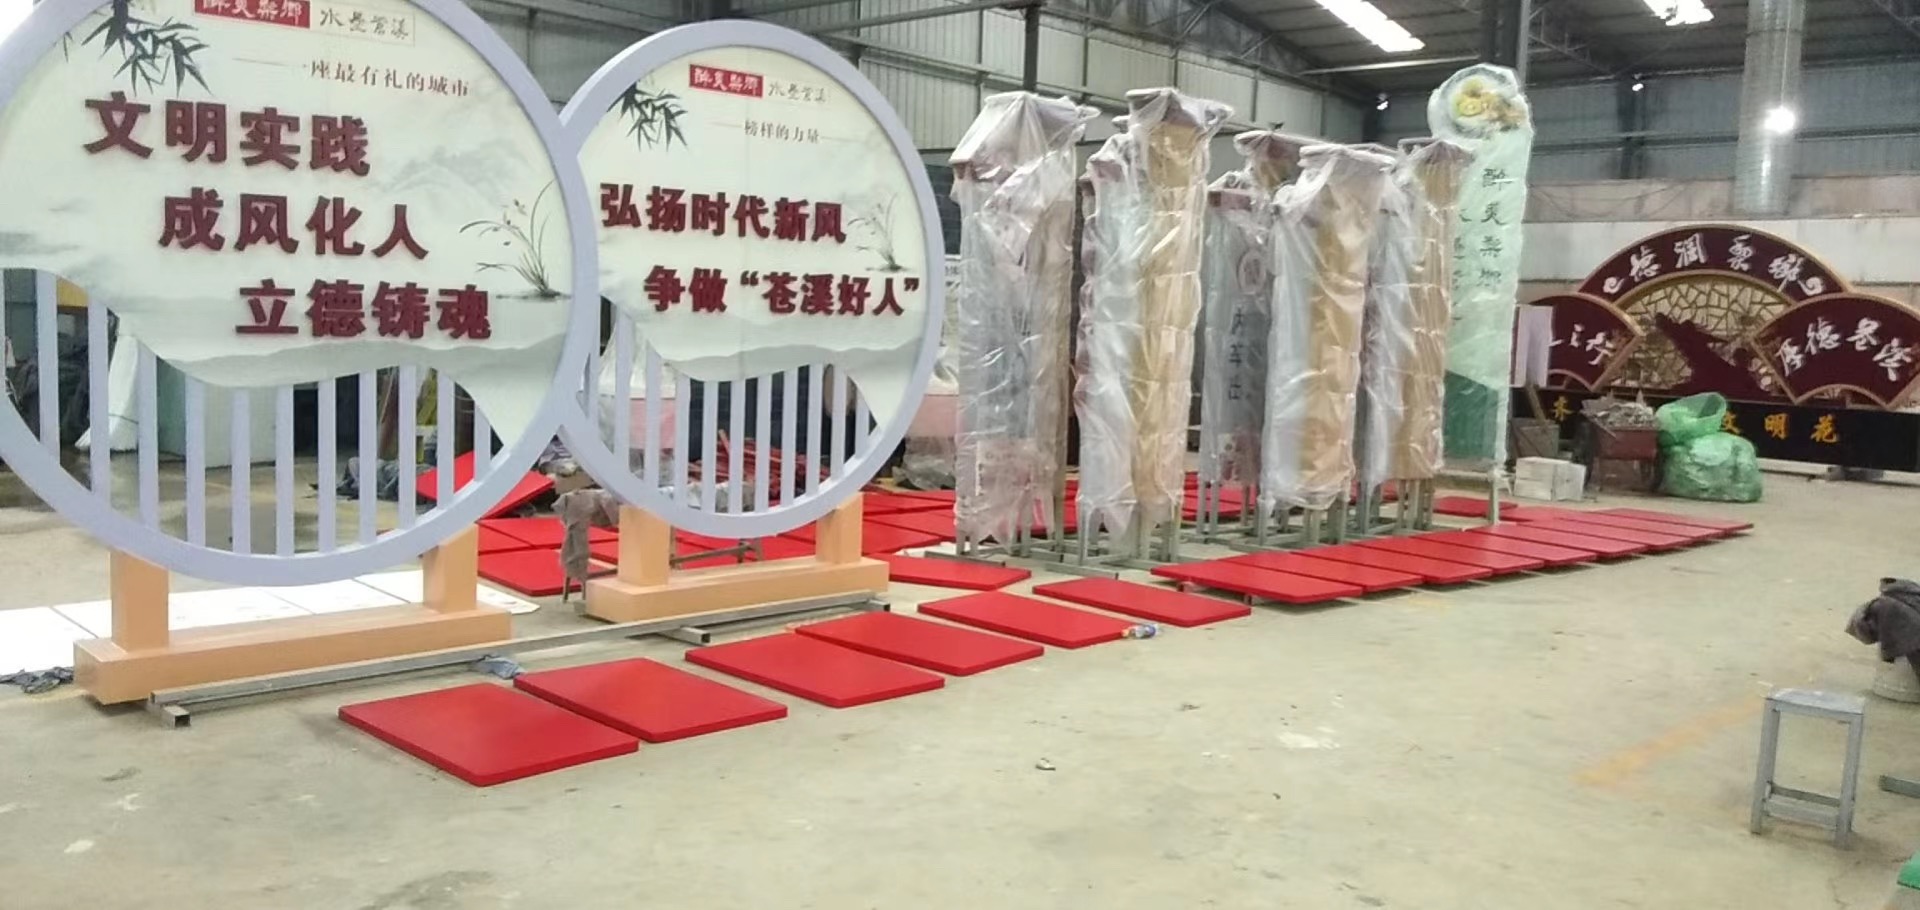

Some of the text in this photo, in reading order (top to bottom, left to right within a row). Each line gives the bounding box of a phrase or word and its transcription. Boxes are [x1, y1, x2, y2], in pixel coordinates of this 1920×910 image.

[83, 90, 371, 178] 文明实践
[743, 119, 820, 143] 榜样的力量
[157, 185, 430, 260] 成风化人
[600, 183, 847, 244] 弘扬时代新风
[235, 278, 492, 340] 立德铸魂
[643, 264, 920, 317] 争做“苍溪好人”
